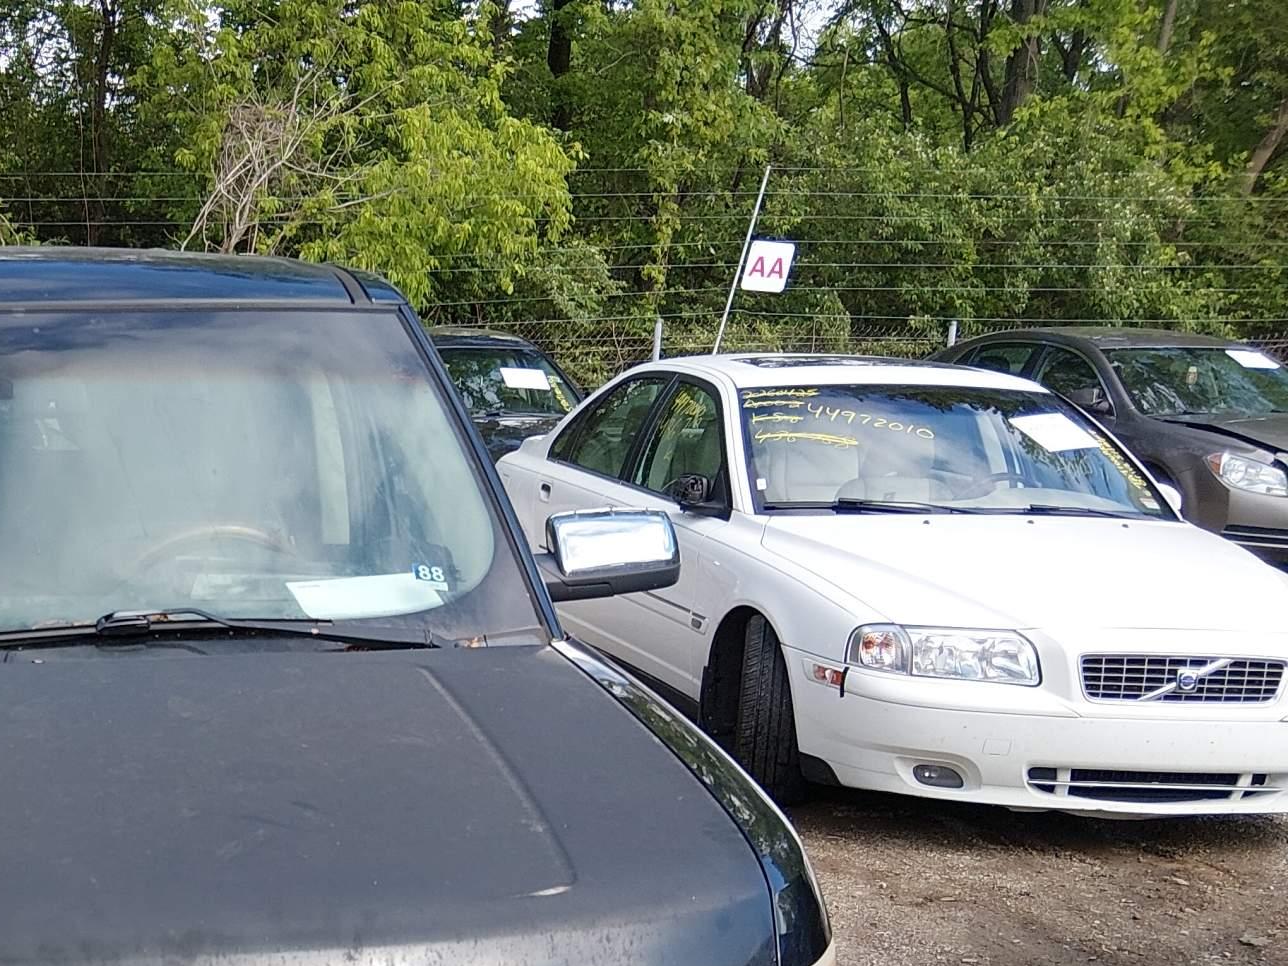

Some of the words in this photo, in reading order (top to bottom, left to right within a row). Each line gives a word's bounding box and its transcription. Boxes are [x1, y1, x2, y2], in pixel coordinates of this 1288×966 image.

[748, 256, 784, 279] AA
[807, 402, 935, 440] 44972010
[417, 564, 445, 582] 88
